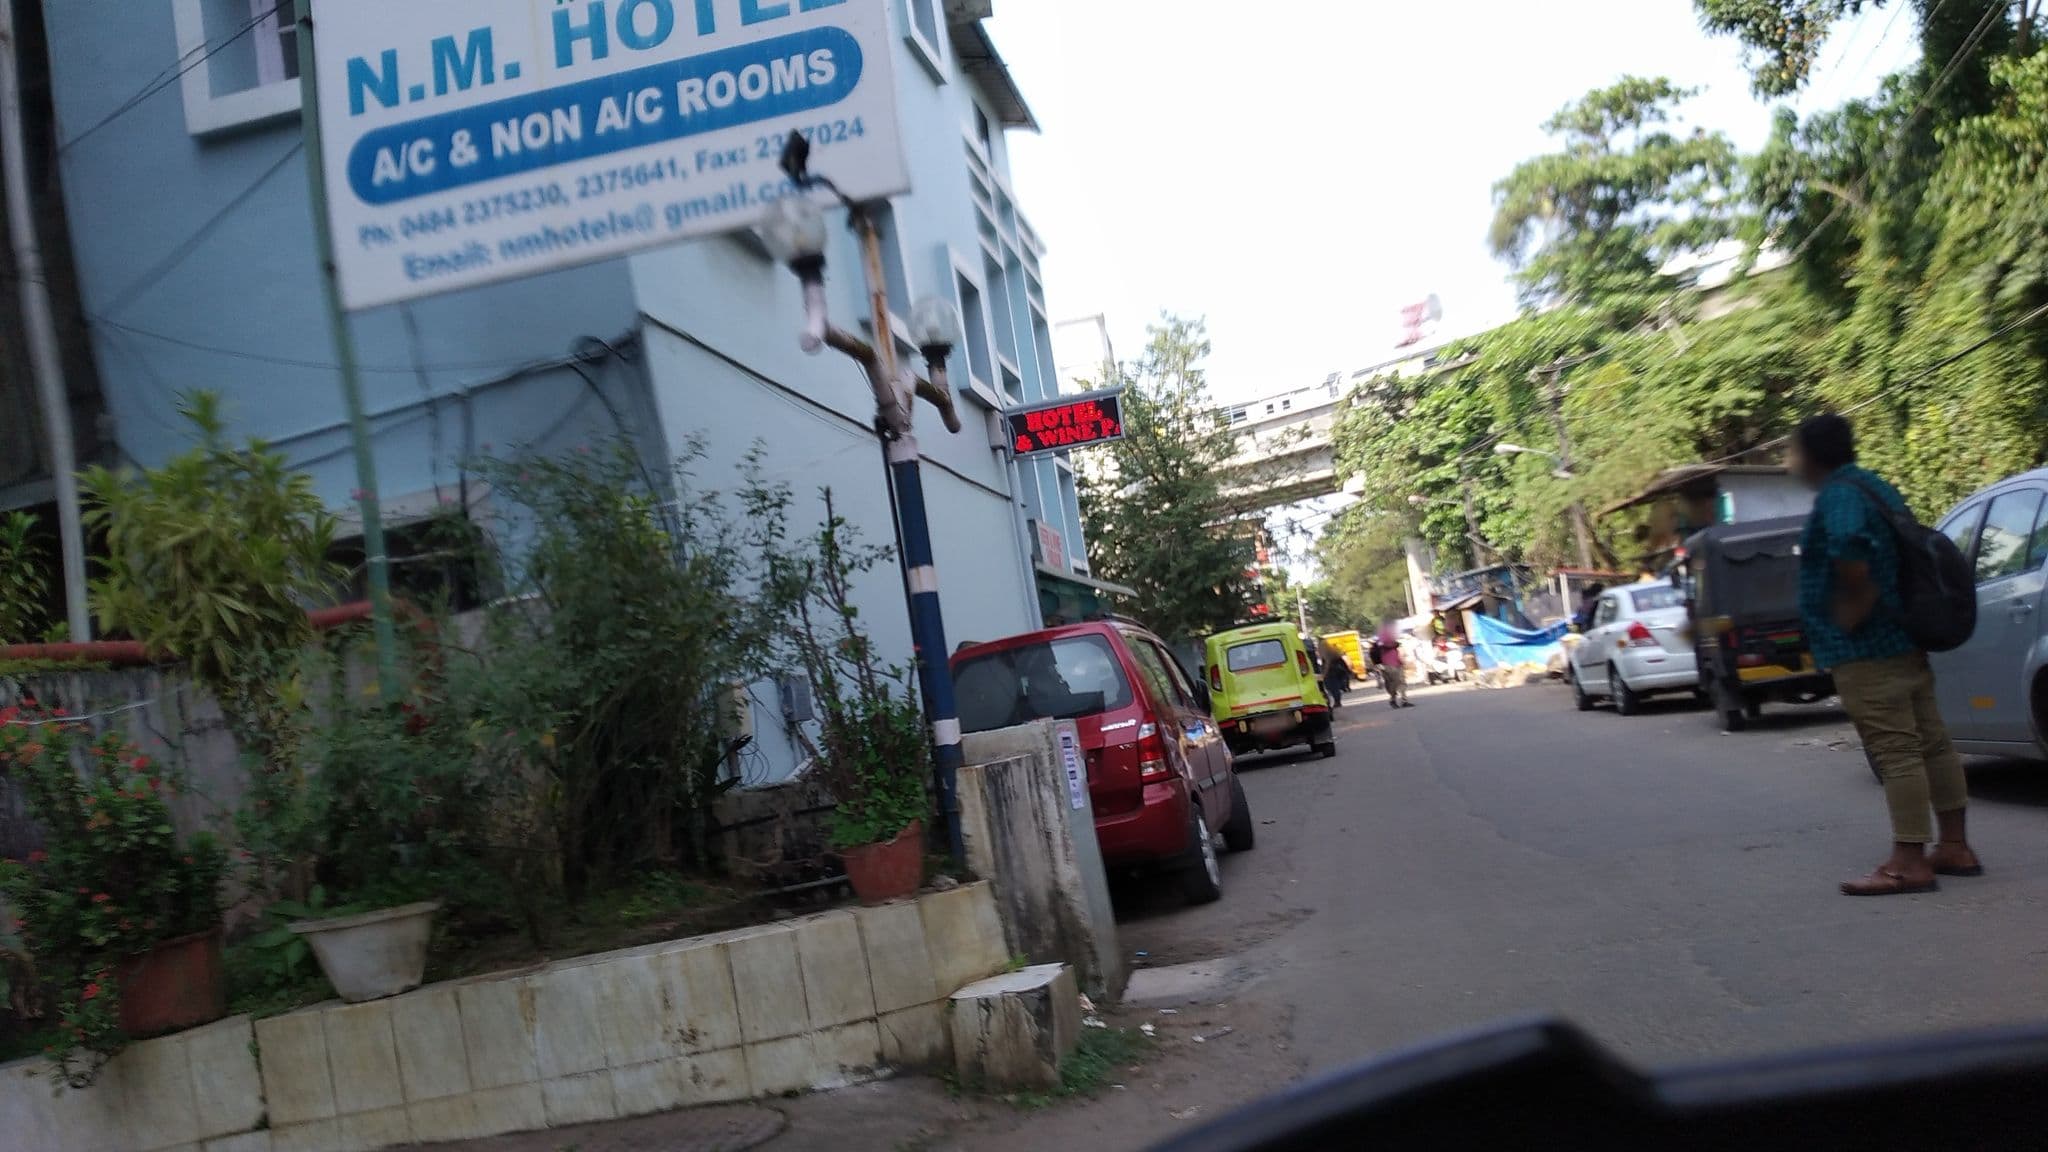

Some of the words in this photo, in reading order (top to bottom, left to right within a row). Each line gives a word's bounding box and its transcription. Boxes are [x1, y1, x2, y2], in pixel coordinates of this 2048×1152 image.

[347, 26, 520, 116] N.M.
[372, 138, 436, 186] A/C
[449, 128, 480, 168] &
[490, 104, 583, 158] NON
[594, 87, 664, 135] A/C
[676, 48, 836, 117] ROOMS
[575, 156, 688, 199] 2375641,
[694, 149, 748, 173] Fax:
[755, 116, 865, 159] 237024
[663, 175, 816, 229] gmail.co
